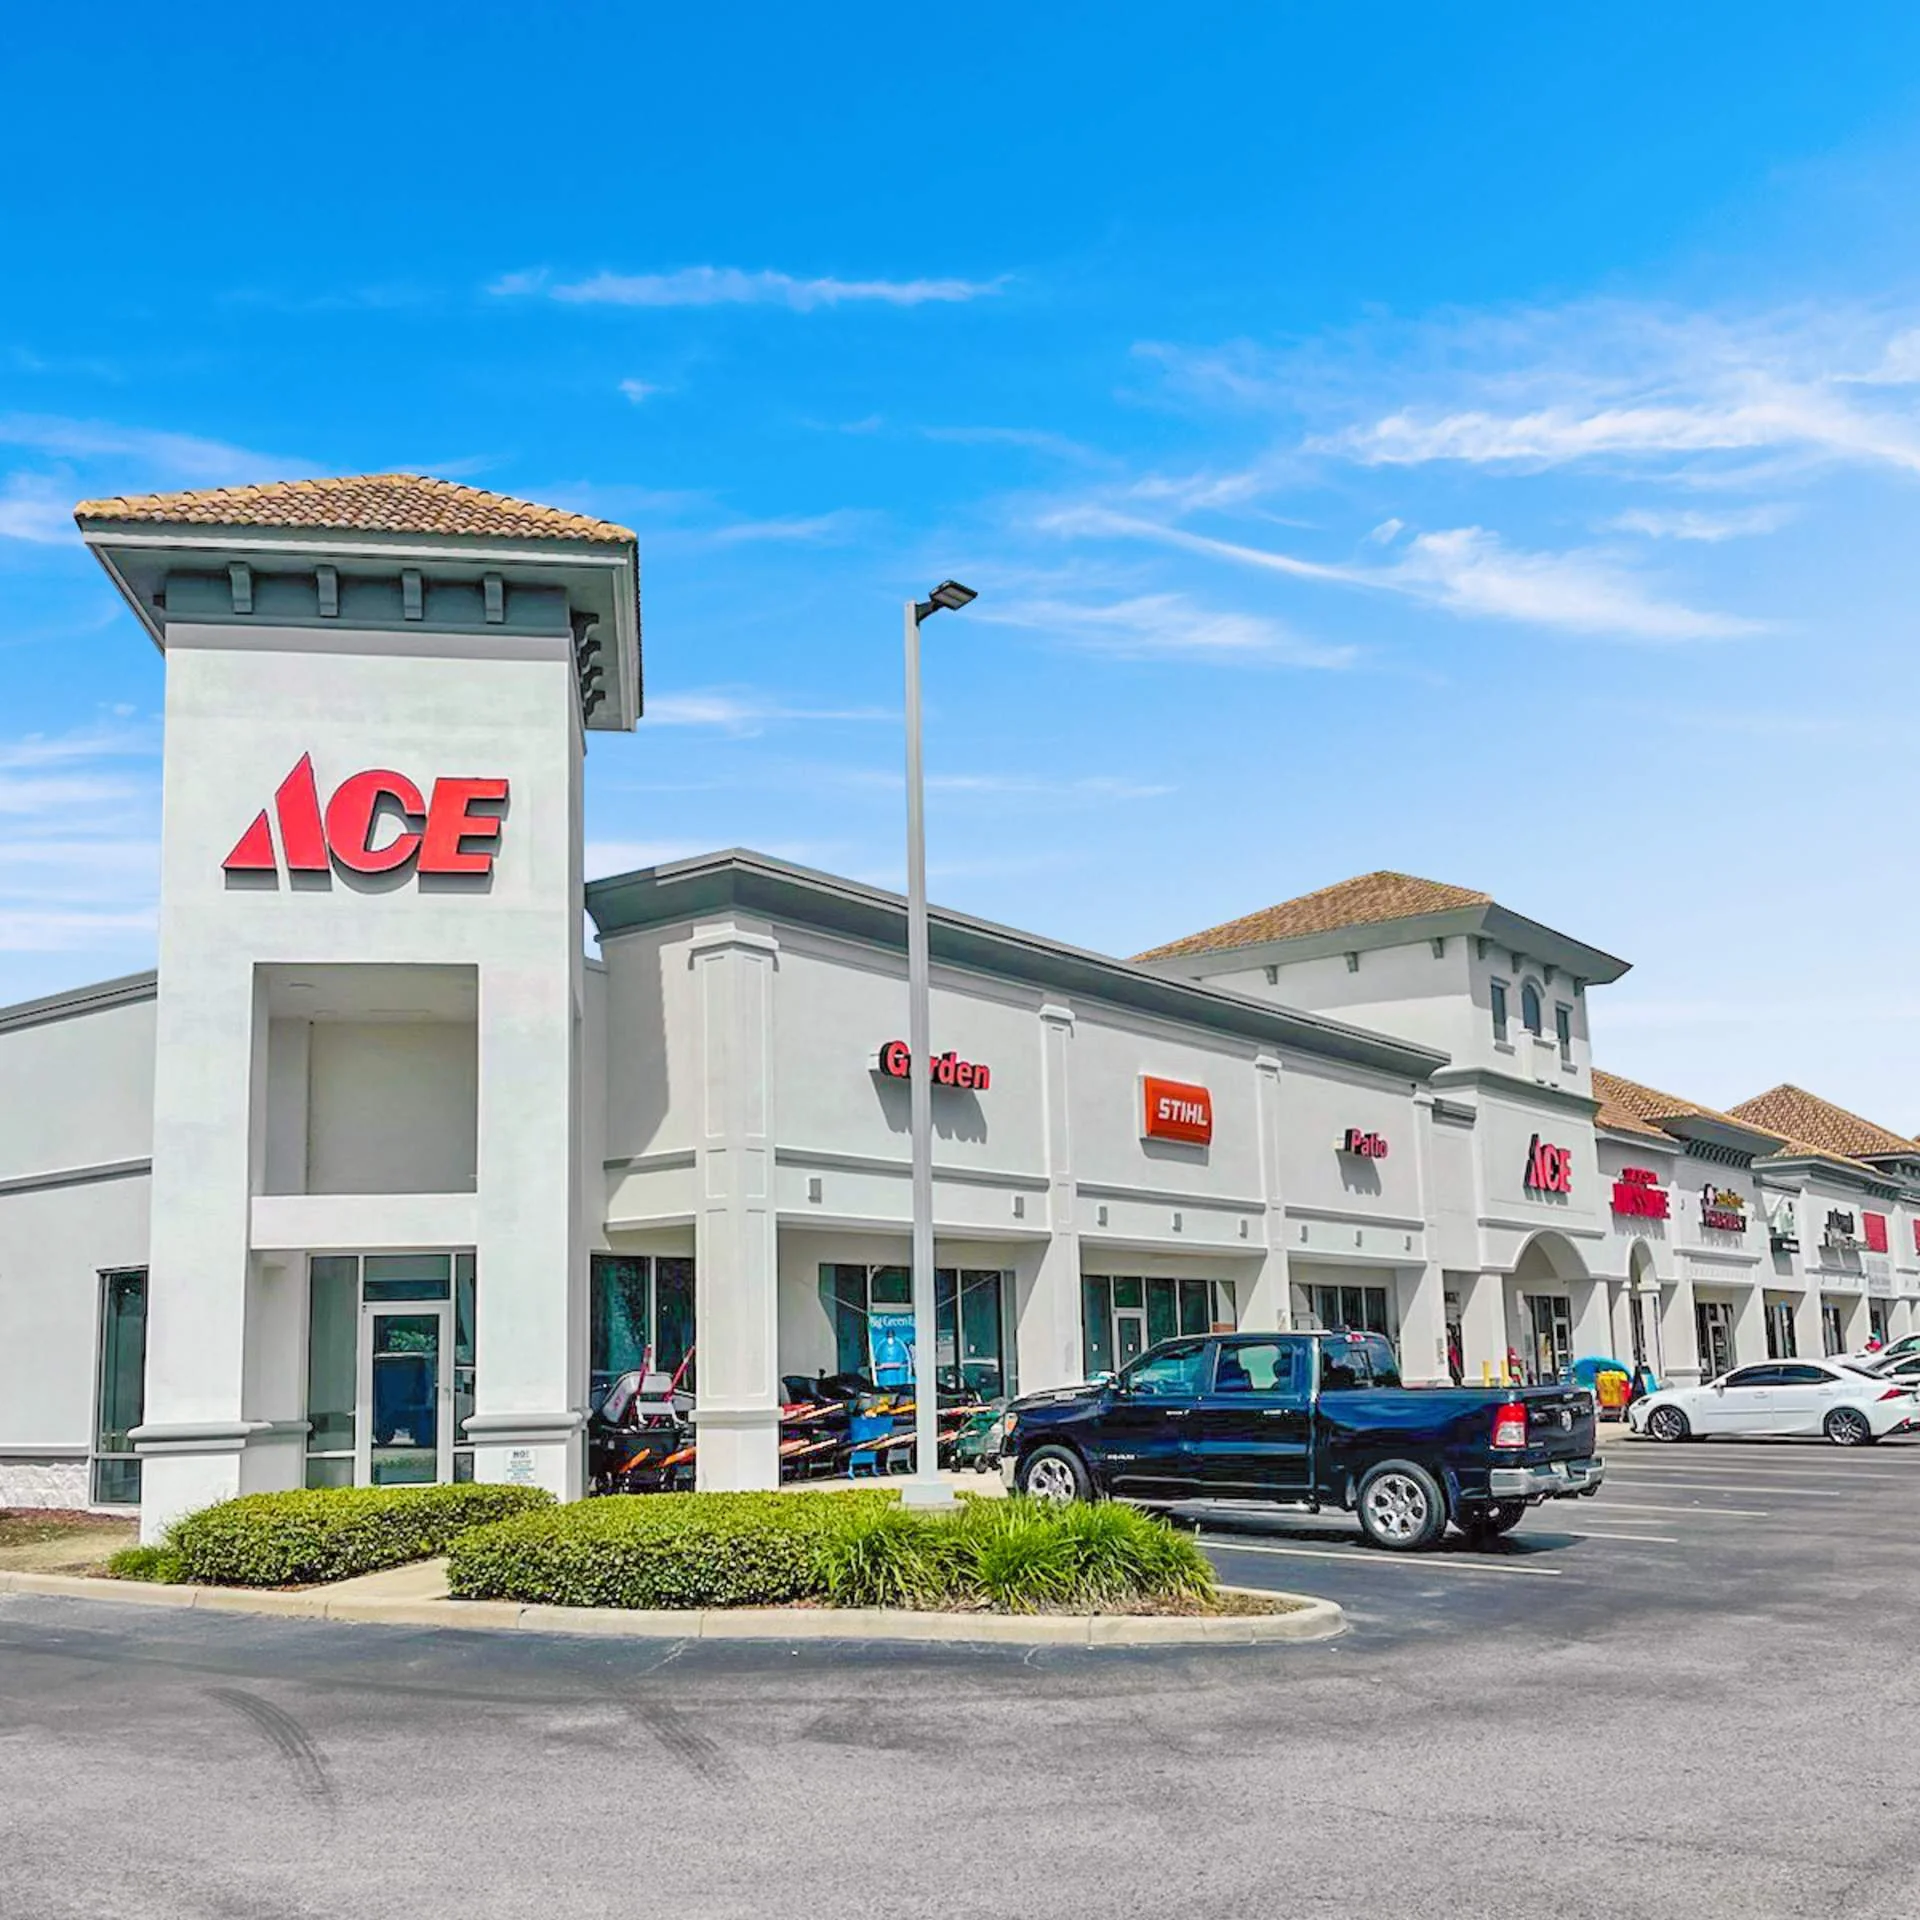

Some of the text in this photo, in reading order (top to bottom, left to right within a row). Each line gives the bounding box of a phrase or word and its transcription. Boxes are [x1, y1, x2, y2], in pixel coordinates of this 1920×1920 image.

[221, 751, 509, 874] ACE
[880, 1040, 990, 1089] Grden
[1158, 1097, 1208, 1126] STIHL
[1524, 1134, 1571, 1193] ACE
